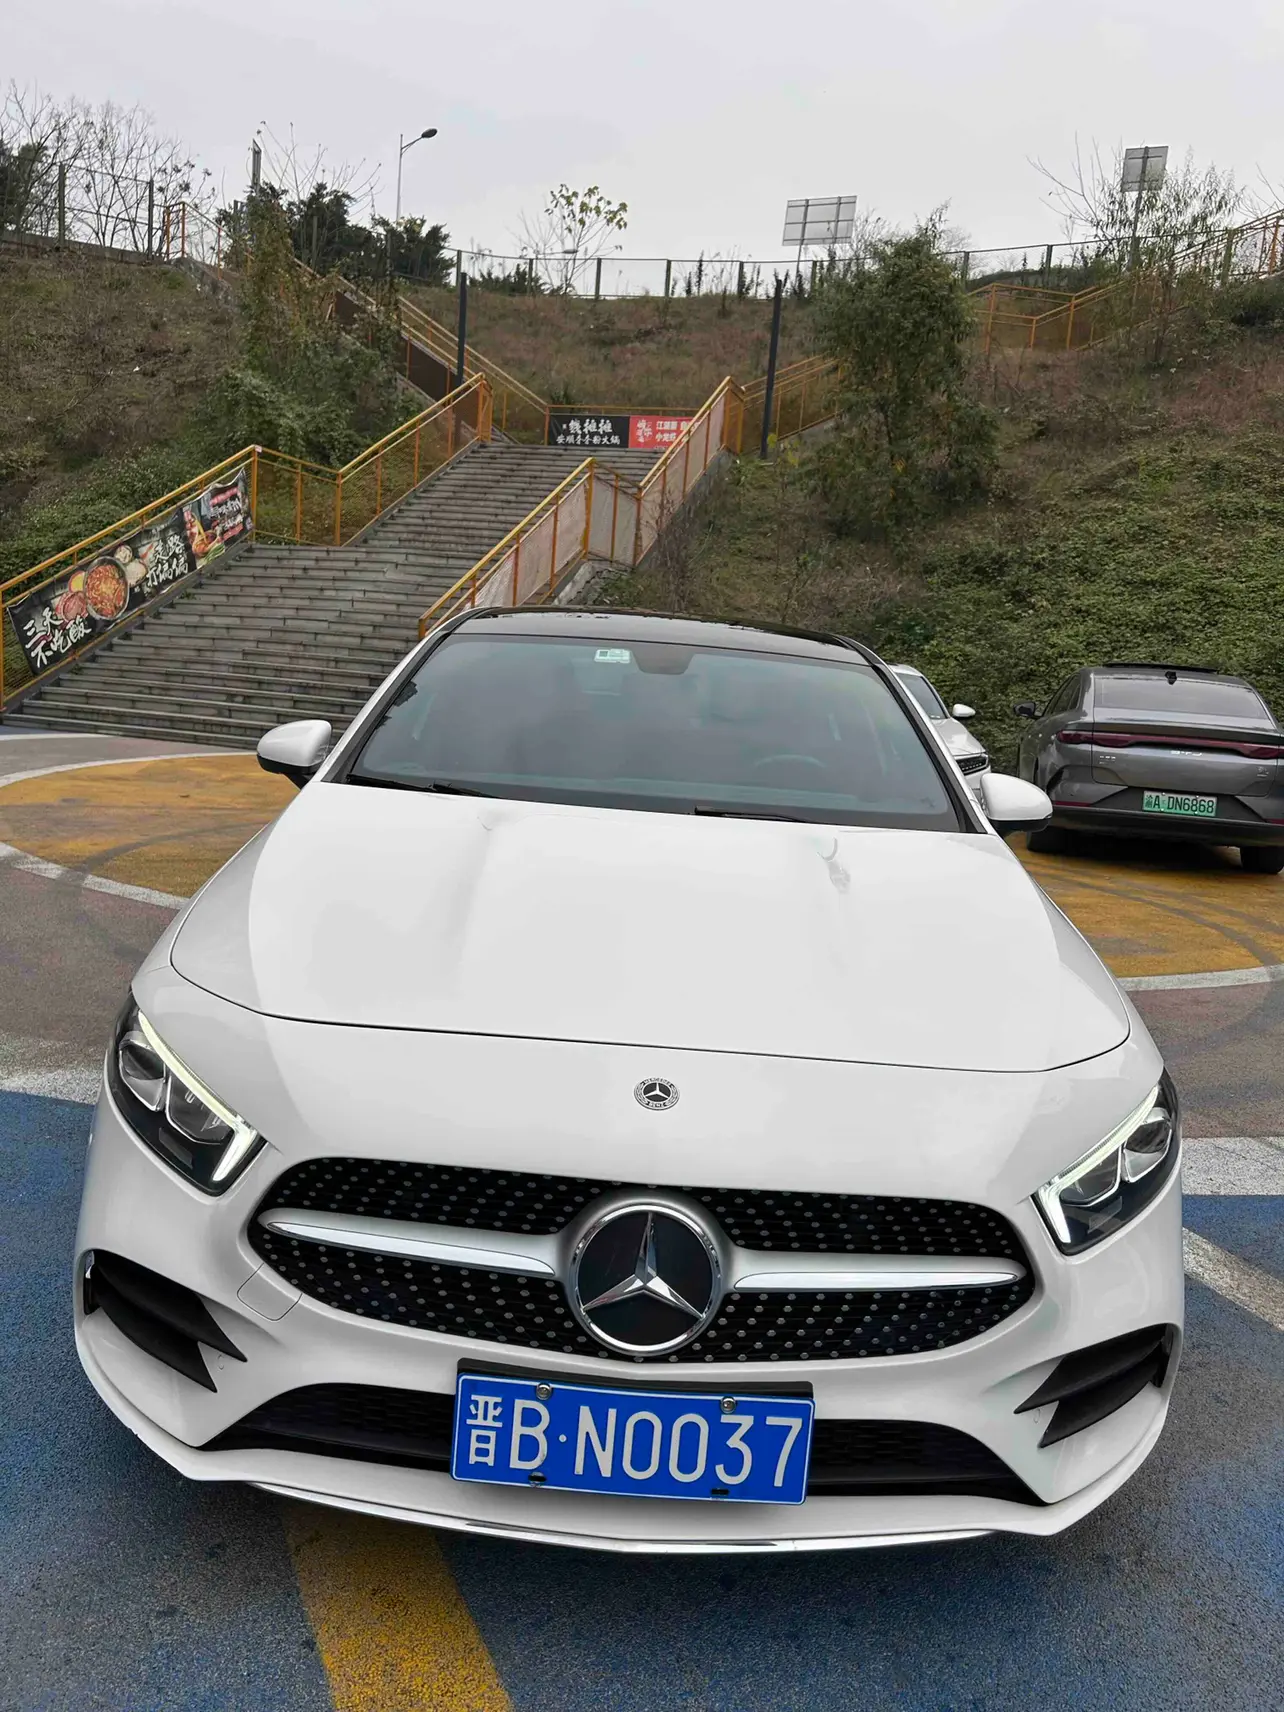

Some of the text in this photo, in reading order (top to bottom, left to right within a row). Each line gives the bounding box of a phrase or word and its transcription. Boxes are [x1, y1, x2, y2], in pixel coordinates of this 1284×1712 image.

[154, 534, 185, 562] 走路
[31, 614, 93, 669] 不吃酸
[465, 1394, 804, 1488] 晋B·N0037
